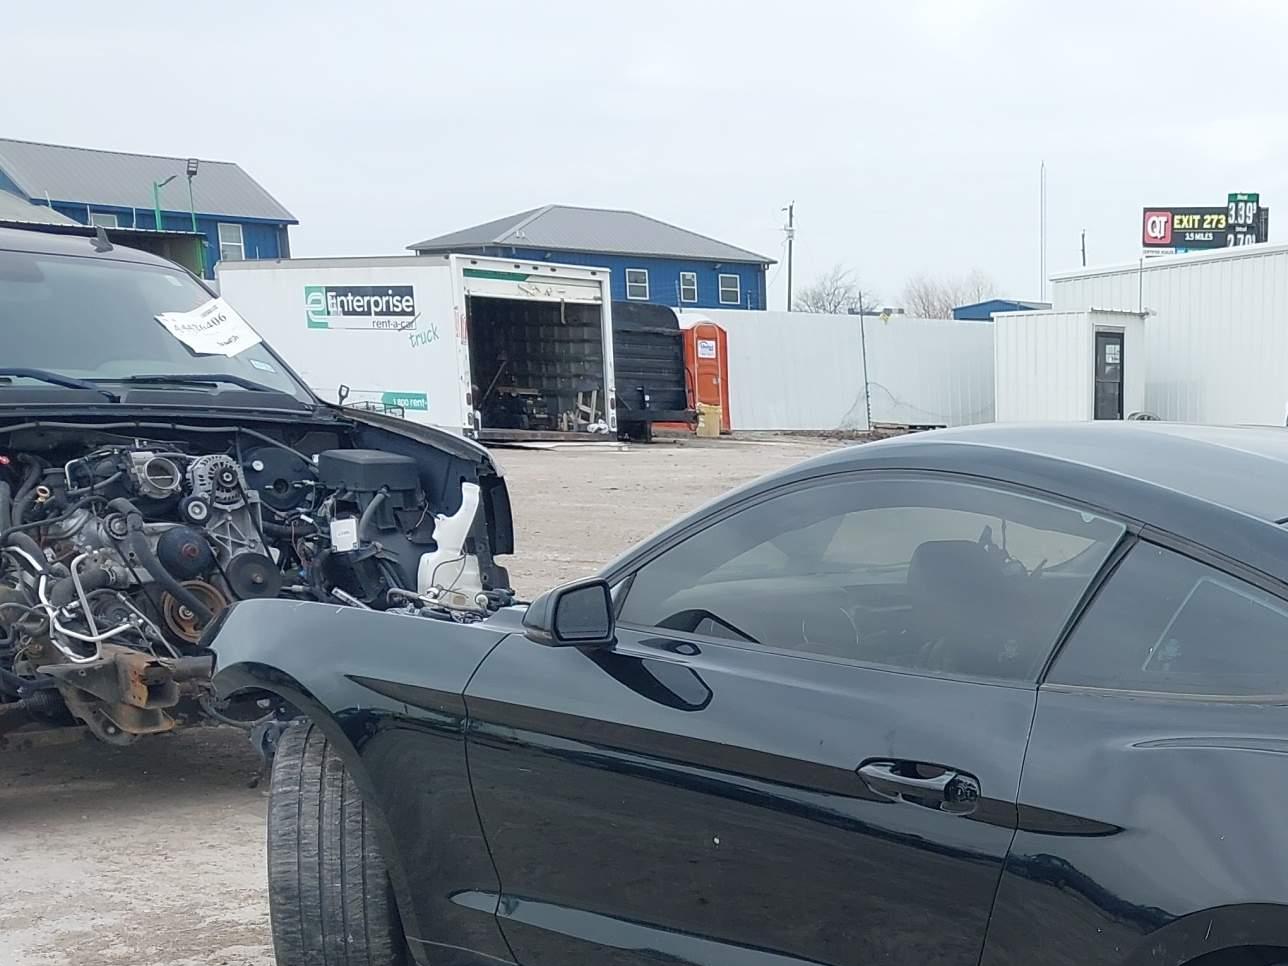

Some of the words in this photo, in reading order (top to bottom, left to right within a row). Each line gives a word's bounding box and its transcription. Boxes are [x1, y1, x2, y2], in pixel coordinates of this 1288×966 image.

[1147, 215, 1168, 238] QT
[1173, 214, 1201, 229] EXIT
[1203, 214, 1226, 229] 273
[1195, 232, 1213, 240] MILES
[327, 289, 413, 316] Enterprise
[408, 323, 439, 348] truck
